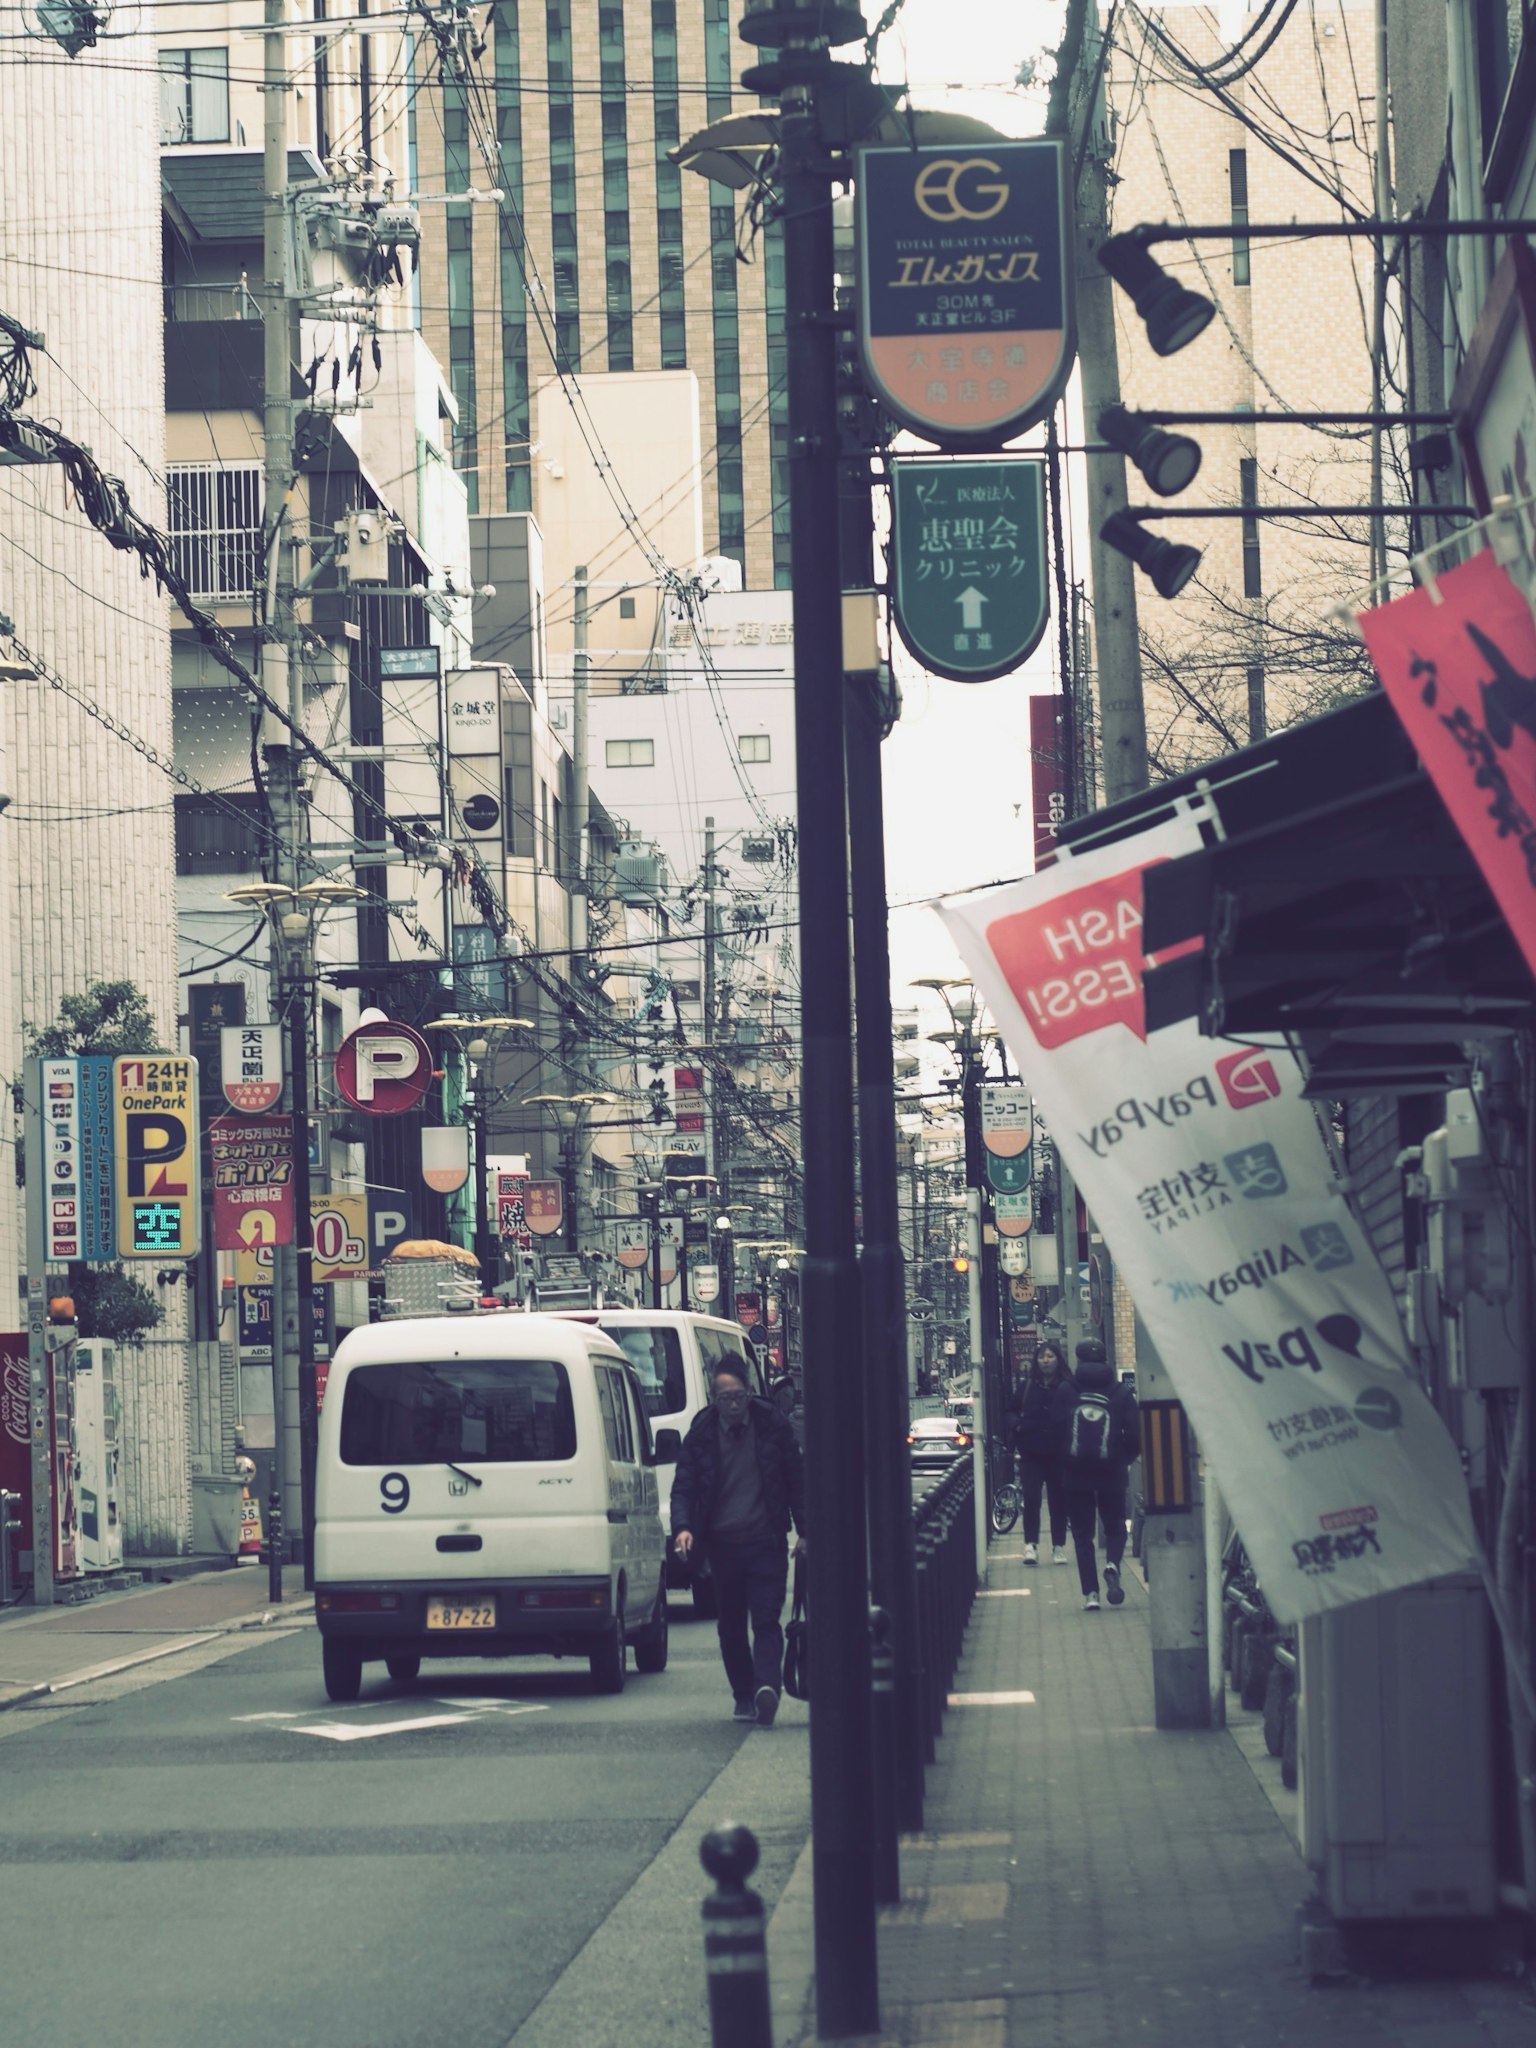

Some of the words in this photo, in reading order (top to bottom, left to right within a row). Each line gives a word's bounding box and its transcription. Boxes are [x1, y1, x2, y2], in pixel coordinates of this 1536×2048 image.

[896, 239, 934, 250] TOTAL
[940, 237, 987, 249] BEAUTY
[992, 235, 1033, 246] SALON
[889, 252, 1041, 287] エレガンス
[957, 485, 1015, 503] 医療法人
[918, 515, 1019, 553] 恵聖会
[915, 556, 1026, 581] クリニック
[953, 632, 993, 651] 直進
[451, 701, 497, 716] 金城堂
[52, 1068, 70, 1076] VISA
[147, 1063, 188, 1078] 24H
[356, 1036, 419, 1100] P
[147, 1081, 187, 1092] 時間貸
[122, 1096, 186, 1110] OnePark
[984, 1103, 1028, 1115] ニッコー
[126, 1113, 187, 1197] P
[214, 1143, 292, 1160] ネットカフェ
[671, 1142, 700, 1152] ISLAY
[216, 1160, 293, 1187] ポパイ
[228, 1187, 282, 1203] 心斎橋店
[135, 1204, 181, 1249] 空
[374, 1211, 406, 1247] P
[311, 1217, 359, 1258] 0円
[354, 1271, 385, 1279] PARKIN
[380, 1472, 410, 1513] 9
[243, 1528, 253, 1540] P
[443, 1608, 492, 1626] 87-22
